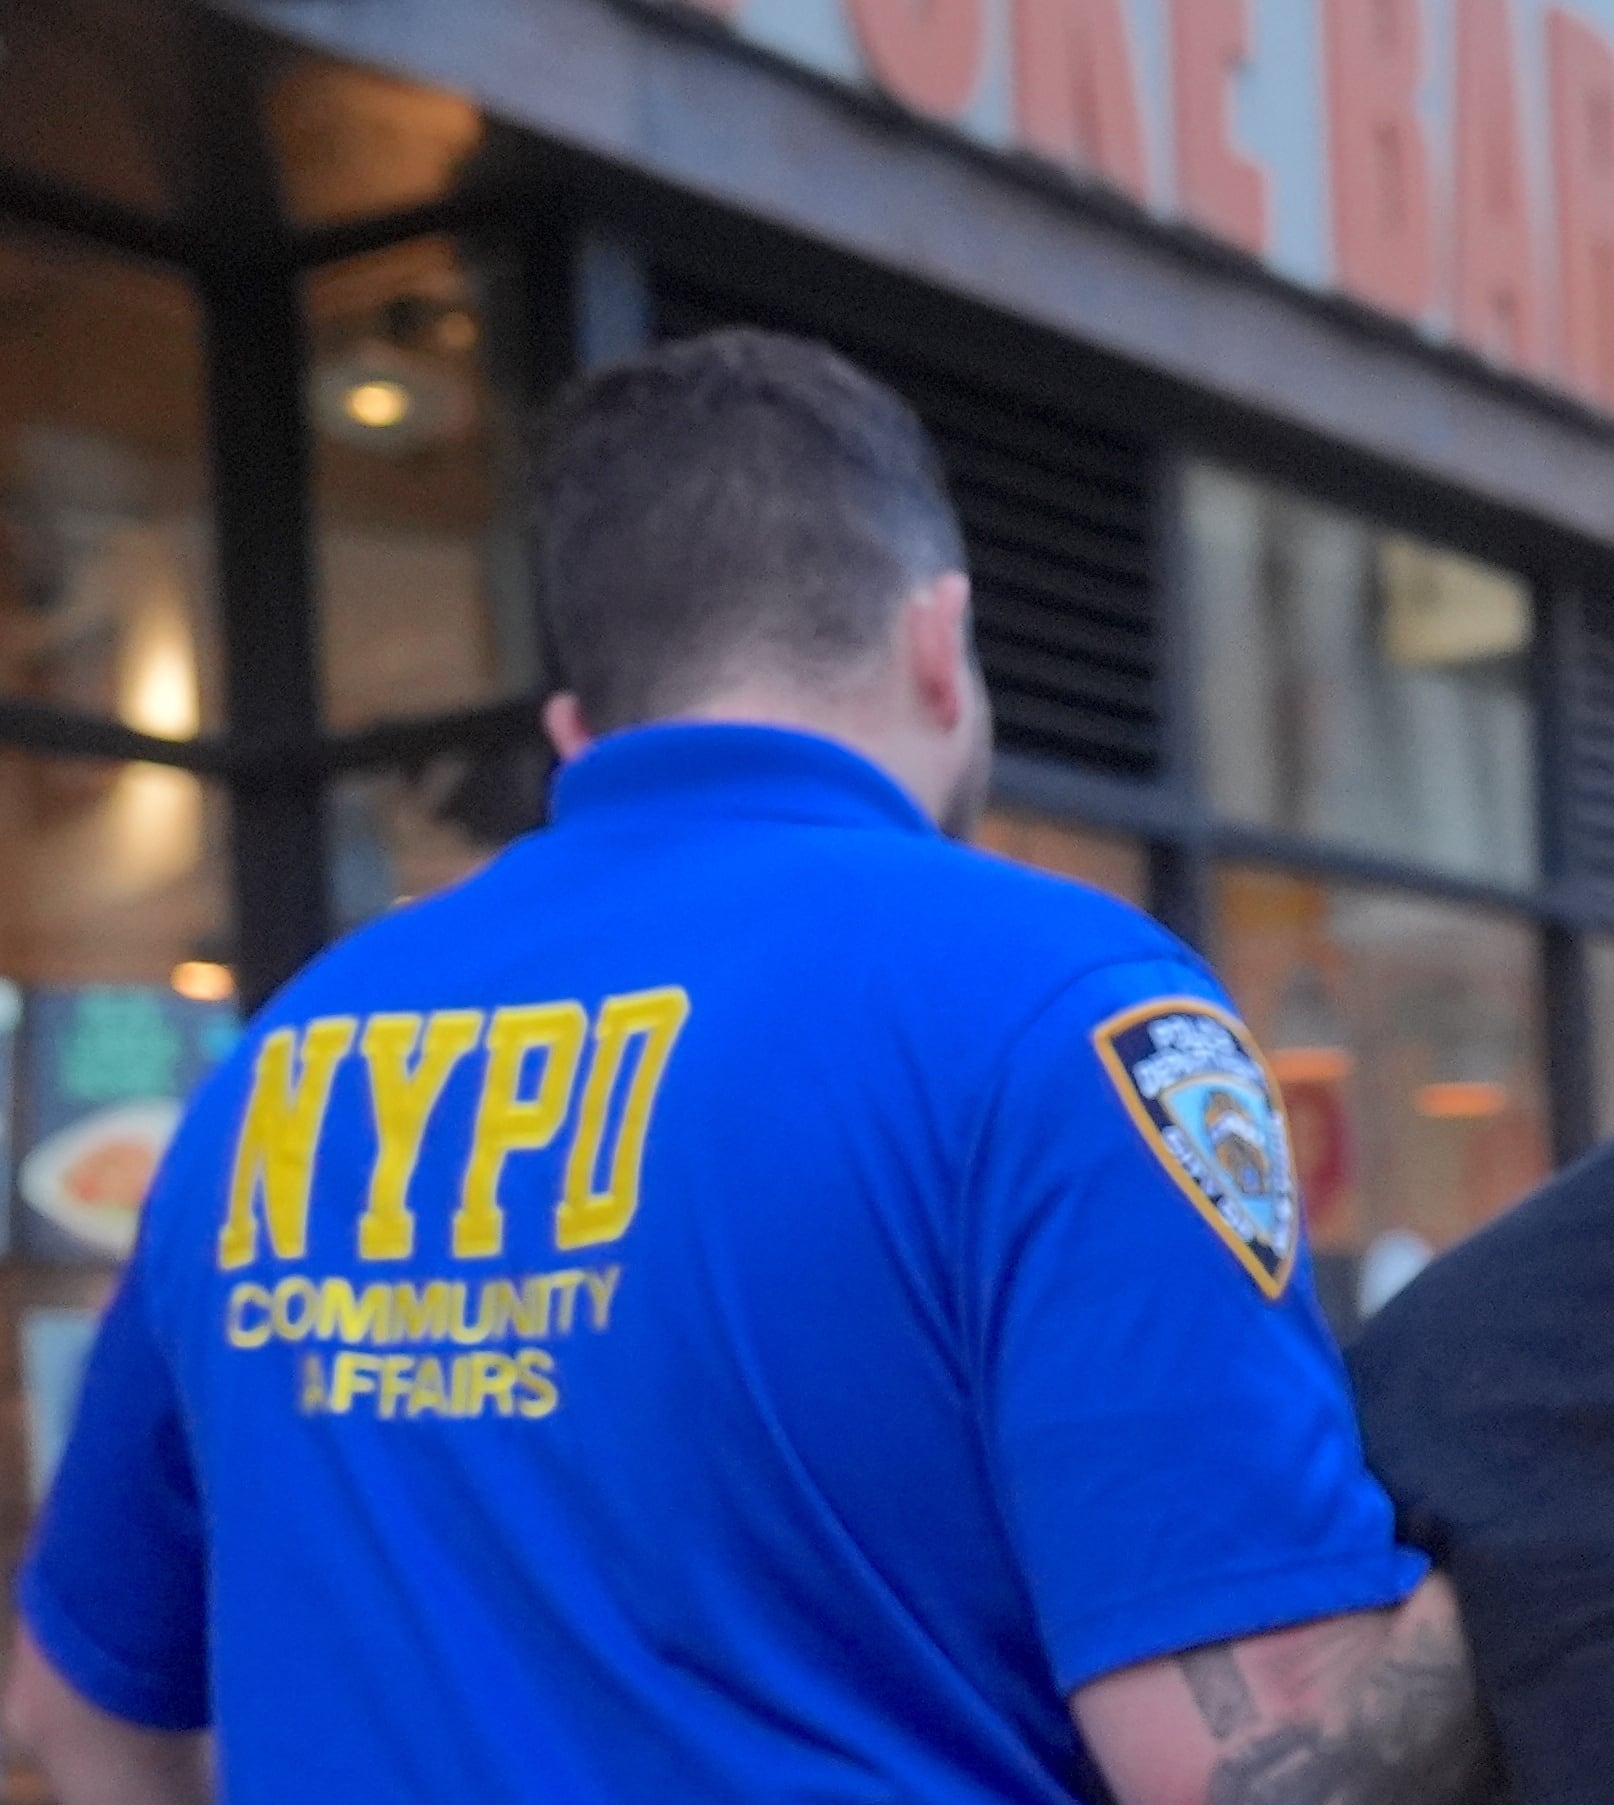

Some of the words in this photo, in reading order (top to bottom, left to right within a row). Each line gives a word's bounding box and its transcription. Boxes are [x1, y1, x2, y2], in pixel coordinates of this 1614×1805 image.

[218, 985, 691, 1271] NYPD
[227, 1263, 622, 1350] COMMUNITY
[297, 1347, 559, 1420] AFFAIRS
